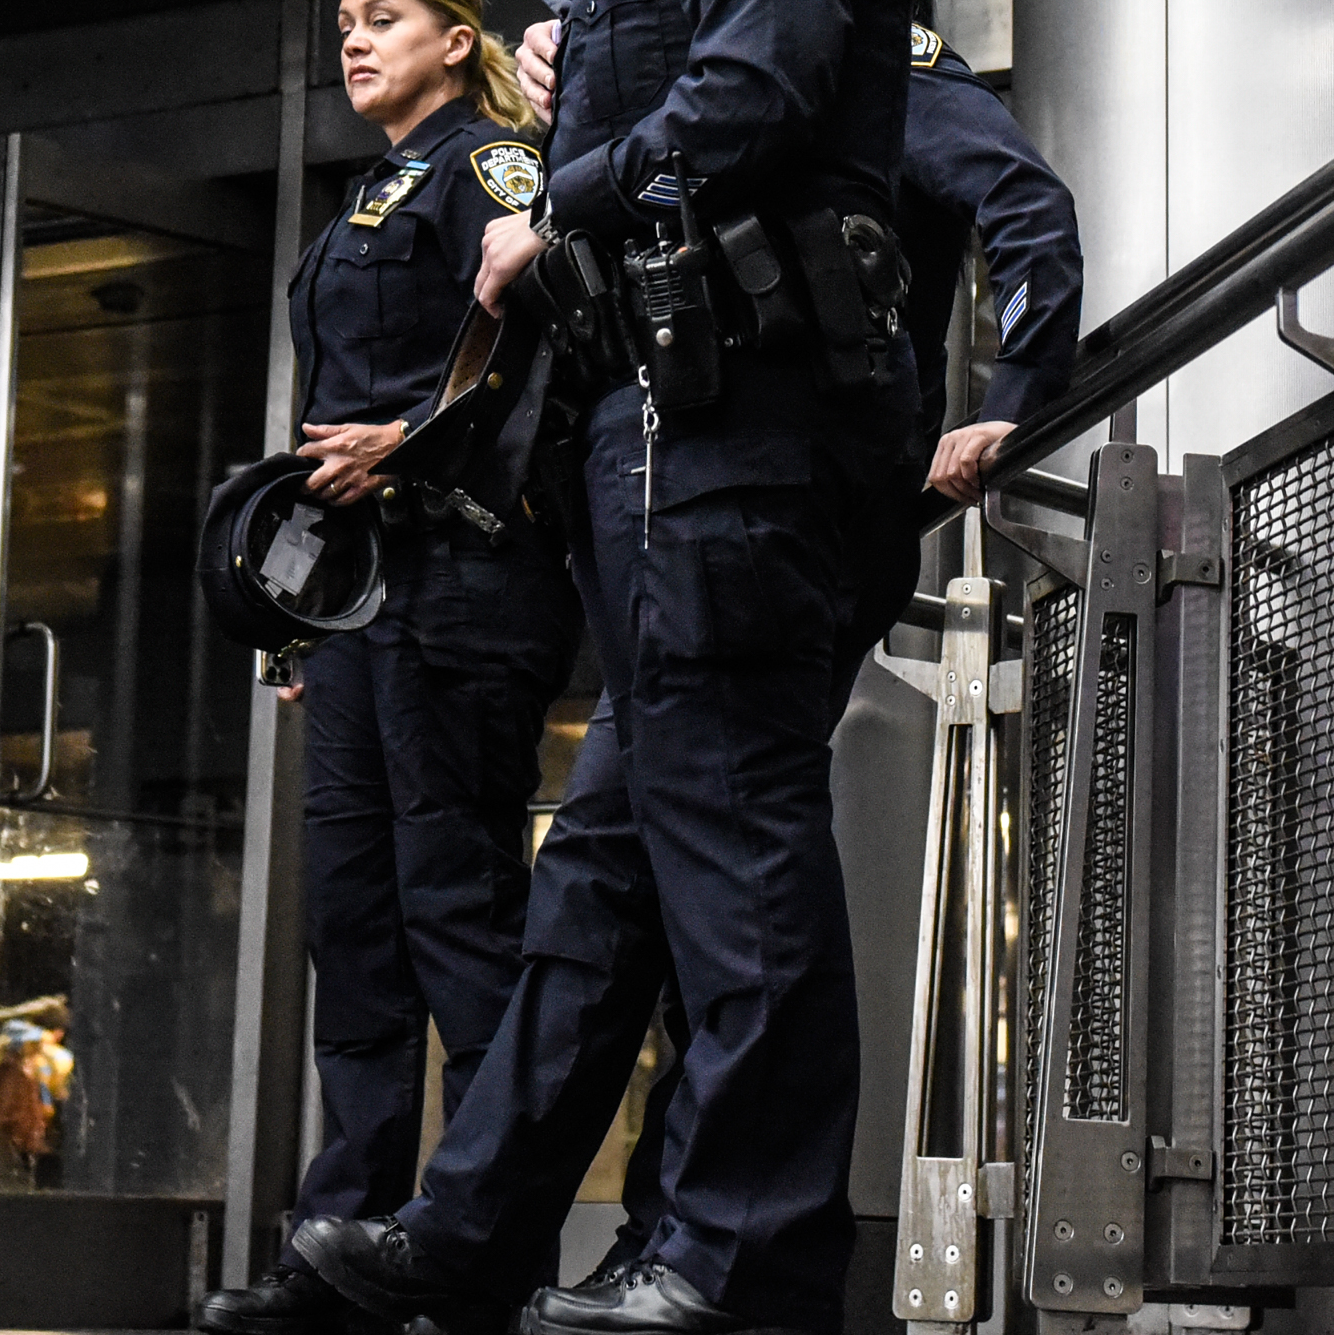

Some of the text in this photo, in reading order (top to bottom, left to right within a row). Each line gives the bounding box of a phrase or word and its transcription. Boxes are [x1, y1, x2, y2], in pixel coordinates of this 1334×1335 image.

[490, 147, 526, 158] POLICE
[481, 155, 539, 171] DEPARTMENT
[486, 179, 520, 206] CITY OF
